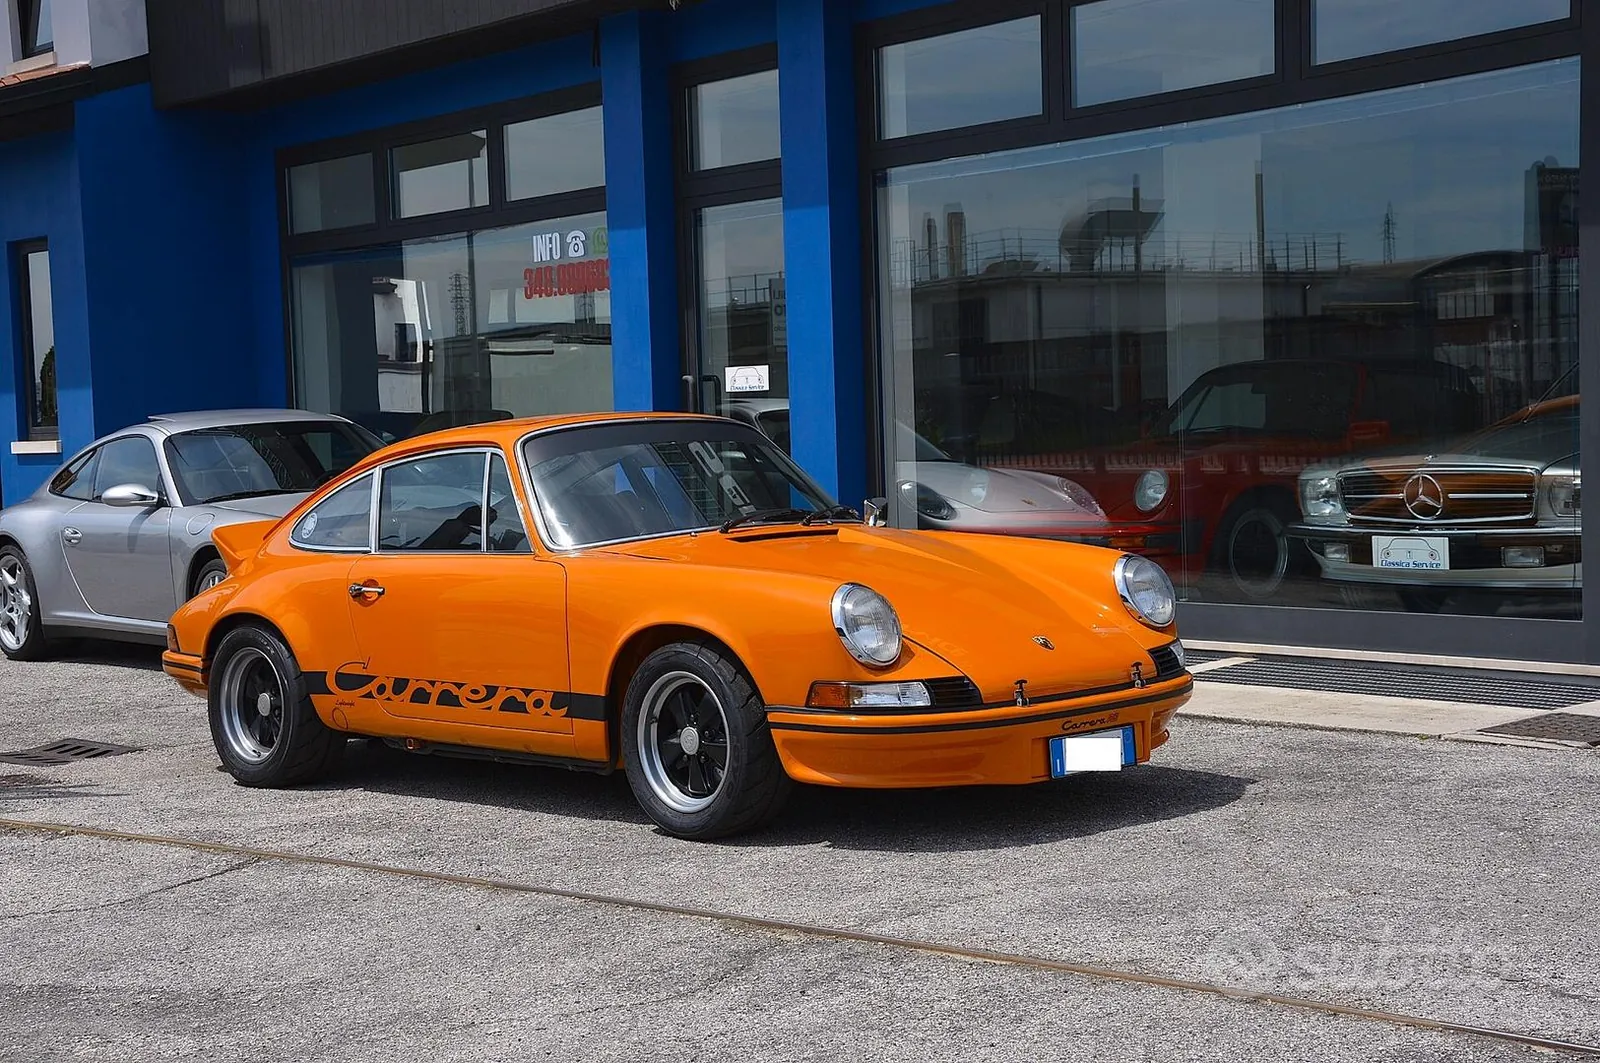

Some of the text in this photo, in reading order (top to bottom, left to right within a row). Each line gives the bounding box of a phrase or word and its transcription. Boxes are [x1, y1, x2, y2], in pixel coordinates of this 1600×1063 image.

[533, 232, 561, 262] INFO
[1380, 560, 1441, 569] Classica Service
[325, 656, 568, 718] Carrera
[1062, 719, 1106, 730] Carrera
